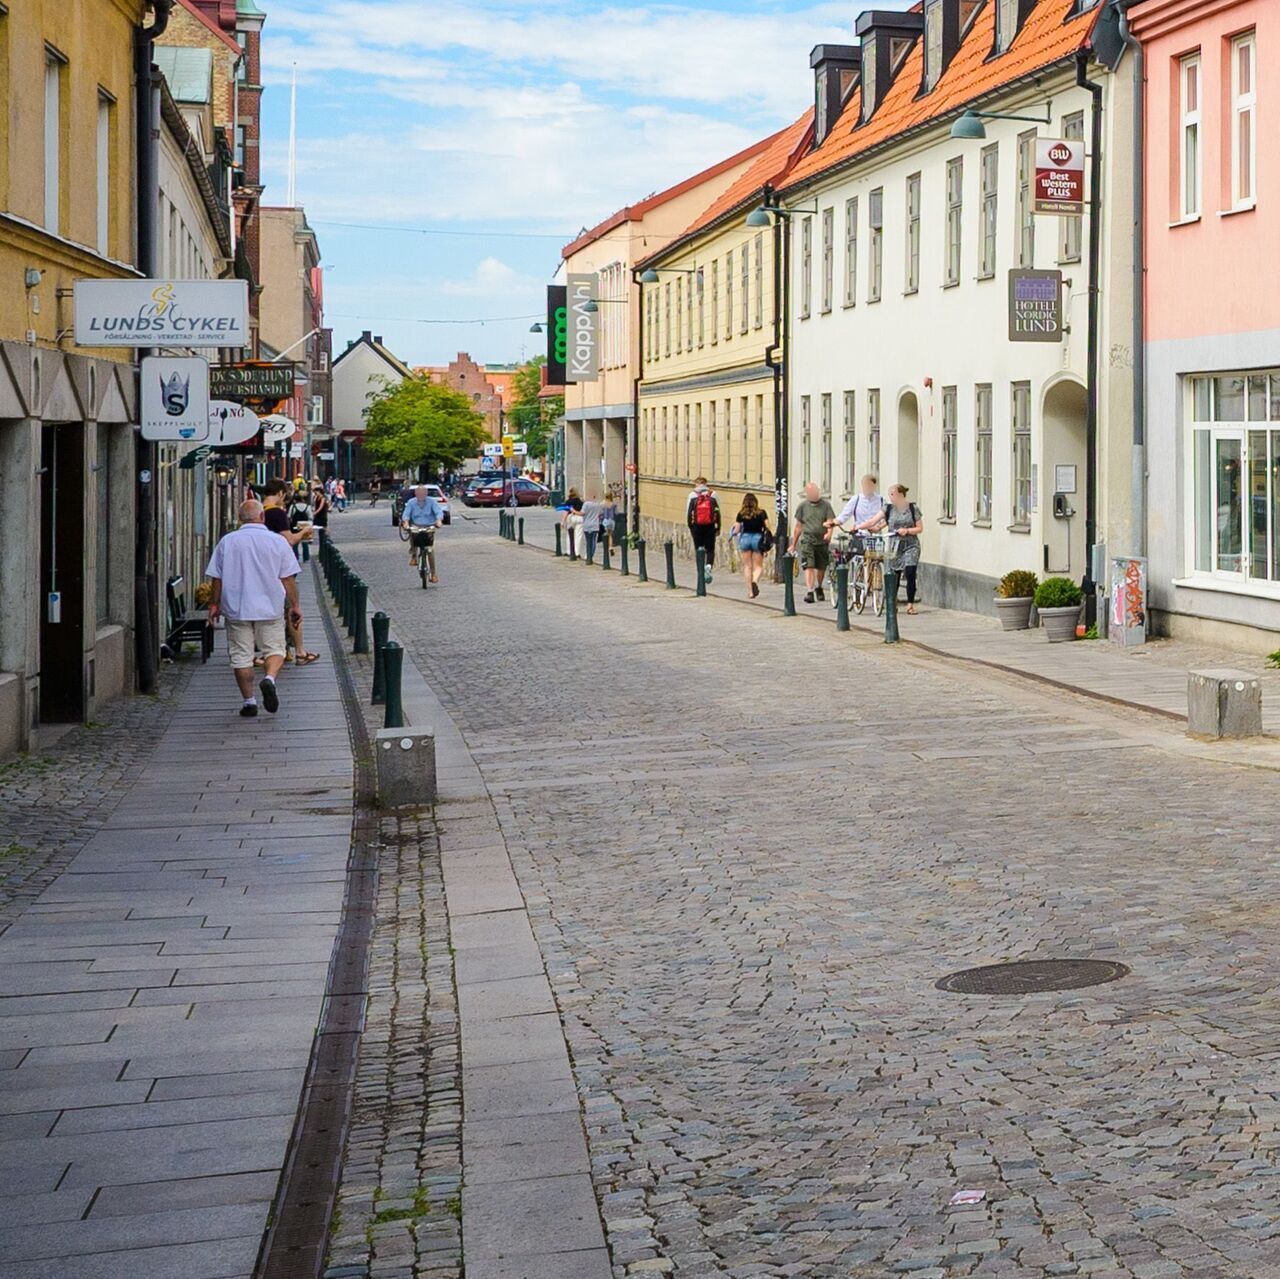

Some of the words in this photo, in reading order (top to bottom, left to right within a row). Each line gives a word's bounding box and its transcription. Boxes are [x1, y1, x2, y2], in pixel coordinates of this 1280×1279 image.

[1050, 149, 1069, 160] BW
[1049, 171, 1069, 181] Best
[1041, 179, 1077, 189] Western
[1047, 188, 1071, 197] PLUS
[1015, 300, 1057, 311] HOTELL
[1015, 310, 1057, 320] NORDIC
[89, 317, 165, 331] LUNDS
[172, 317, 240, 331] CYKEL
[1015, 319, 1058, 332] LUND
